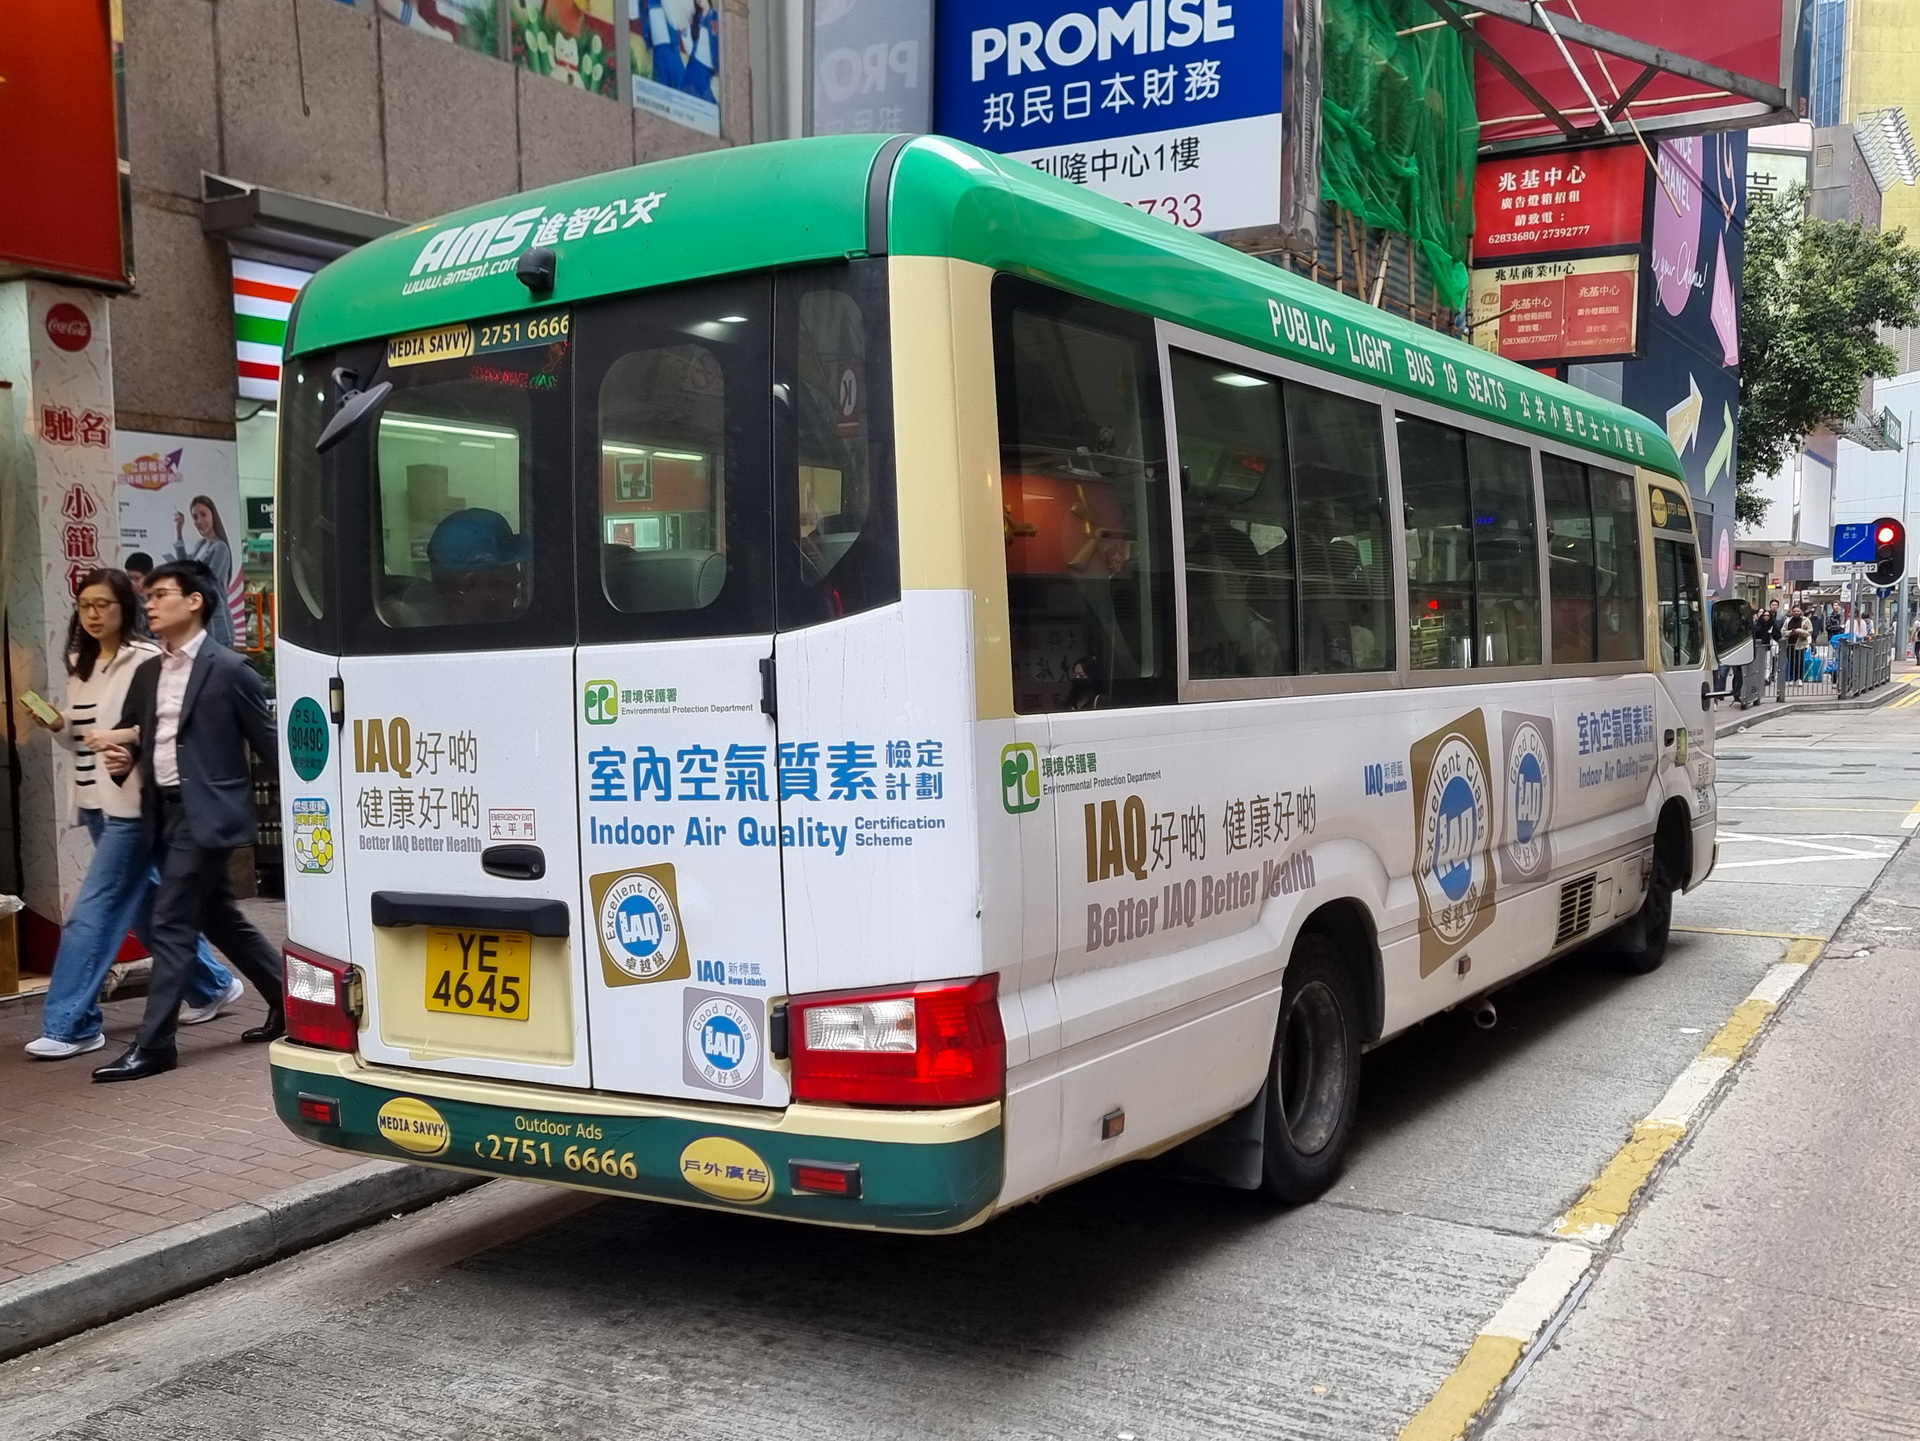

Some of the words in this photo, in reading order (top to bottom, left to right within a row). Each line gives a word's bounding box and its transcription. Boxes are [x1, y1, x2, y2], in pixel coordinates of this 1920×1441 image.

[971, 0, 1235, 82] PROMISE
[982, 60, 1222, 134] 邦民日本財務
[1498, 165, 1586, 192] 兆基中心
[1659, 153, 1690, 212] CHANEL
[1122, 193, 1202, 228] 733
[1501, 190, 1580, 210] 廣告燈箱招租
[531, 192, 667, 248] 進智公交
[410, 206, 546, 277] AMS
[402, 256, 519, 296] www.amspt.com
[1495, 263, 1576, 282] 兆基商業中心
[1511, 298, 1552, 310] 兆基中心
[1579, 285, 1620, 298] 兆基中心
[388, 337, 426, 360] MEDIA
[430, 330, 468, 352] SAVVY
[481, 323, 520, 347] 2751
[527, 314, 569, 340] 6666
[1268, 299, 1336, 356] PUBLIC
[1346, 327, 1394, 375] LIGHT
[1404, 348, 1435, 387] BUS
[1442, 361, 1458, 394] 19
[1466, 370, 1507, 410] SEATS
[43, 408, 109, 447] 馳名
[1520, 391, 1646, 456] 公共小型巴士十九座位
[621, 688, 677, 704] 環境保護署
[621, 705, 670, 715] Environmental
[672, 704, 709, 714] Protection
[710, 703, 753, 714] Department
[292, 726, 324, 753] 9049C
[886, 740, 944, 768] 檢定
[1042, 752, 1097, 778] 環境保護署
[885, 772, 943, 800] 計劃
[1043, 781, 1092, 796] Environmental
[1094, 775, 1126, 788] Protection
[1127, 770, 1162, 784] Department
[1364, 763, 1383, 796] IAQ
[356, 786, 479, 830] 健康好啲
[1223, 786, 1316, 856] 健康好啲
[1423, 750, 1460, 880] Excellent
[1466, 756, 1484, 840] Class
[492, 822, 532, 836] 太平門
[590, 816, 674, 845] Indoor
[686, 817, 726, 846] Air
[738, 816, 848, 856] Quality
[854, 816, 945, 830] Certification
[359, 835, 390, 851] Better
[392, 836, 408, 853] IAQ
[412, 836, 444, 852] Better
[446, 836, 482, 853] Health
[855, 834, 912, 846] Scheme
[606, 882, 642, 940] Excellent
[648, 886, 671, 932] Class
[1086, 895, 1158, 953] Better
[1162, 878, 1196, 931] IAQ
[1200, 869, 1258, 920] Better
[1262, 850, 1316, 900] Health
[458, 933, 499, 972] YE
[625, 952, 666, 974] 卓越級
[697, 960, 726, 985] IAQ
[728, 976, 743, 985] New
[744, 976, 766, 987] Labels
[432, 970, 520, 1014] 4645
[692, 1004, 719, 1031] Good
[725, 1004, 752, 1040] Class
[704, 1064, 742, 1084] 良好級
[379, 1115, 410, 1132] MEDIA
[413, 1119, 444, 1138] SAVVY
[514, 1116, 571, 1137] Outdoor
[575, 1122, 602, 1140] Ads
[487, 1134, 552, 1168] 2751
[564, 1146, 638, 1180] 6666
[682, 1160, 768, 1184] 戶外廣告
